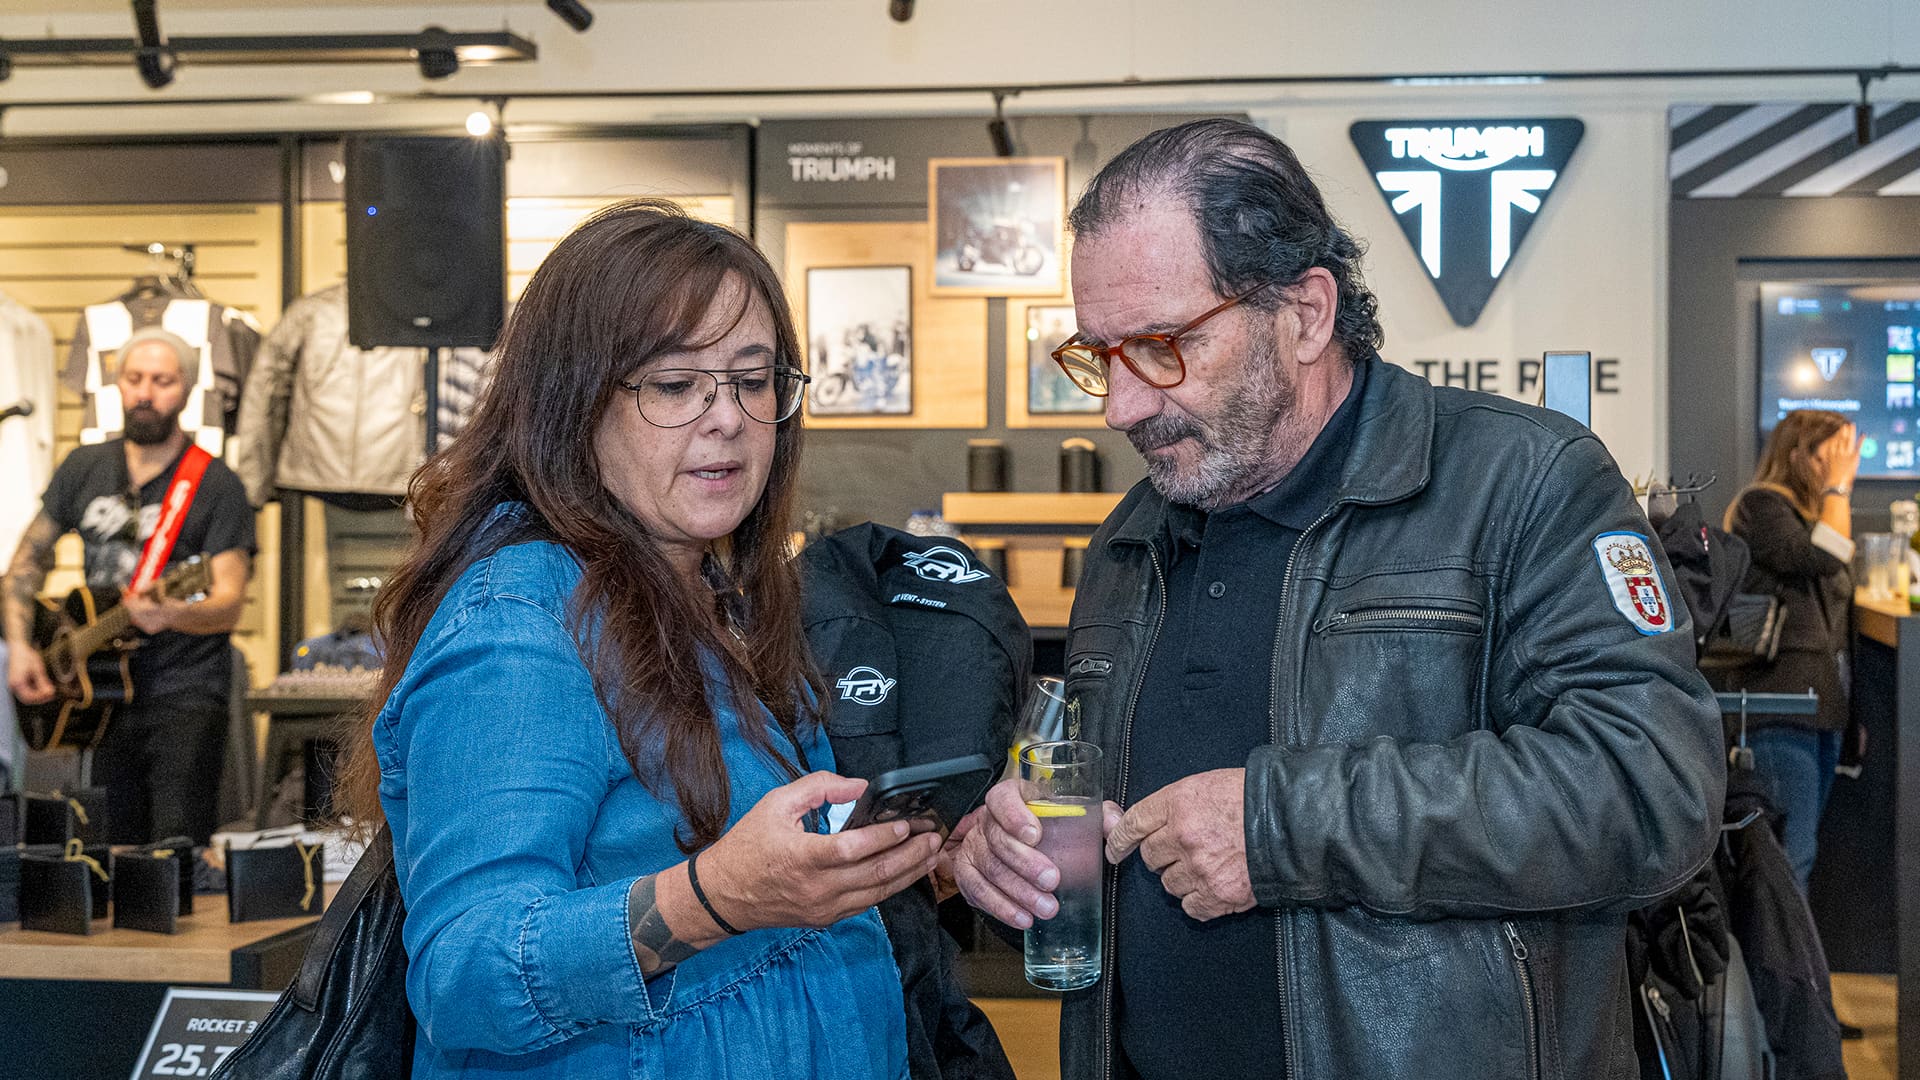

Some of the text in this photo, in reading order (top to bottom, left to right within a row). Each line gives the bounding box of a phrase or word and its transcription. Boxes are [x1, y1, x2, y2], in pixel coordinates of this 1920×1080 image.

[1385, 126, 1544, 158] TRIUMPH
[788, 157, 896, 181] TRIUMPH
[1414, 360, 1619, 393] THE RE
[919, 598, 947, 609] SYSTEM
[836, 678, 897, 700] TRY
[186, 1018, 258, 1034] ROCKET 3
